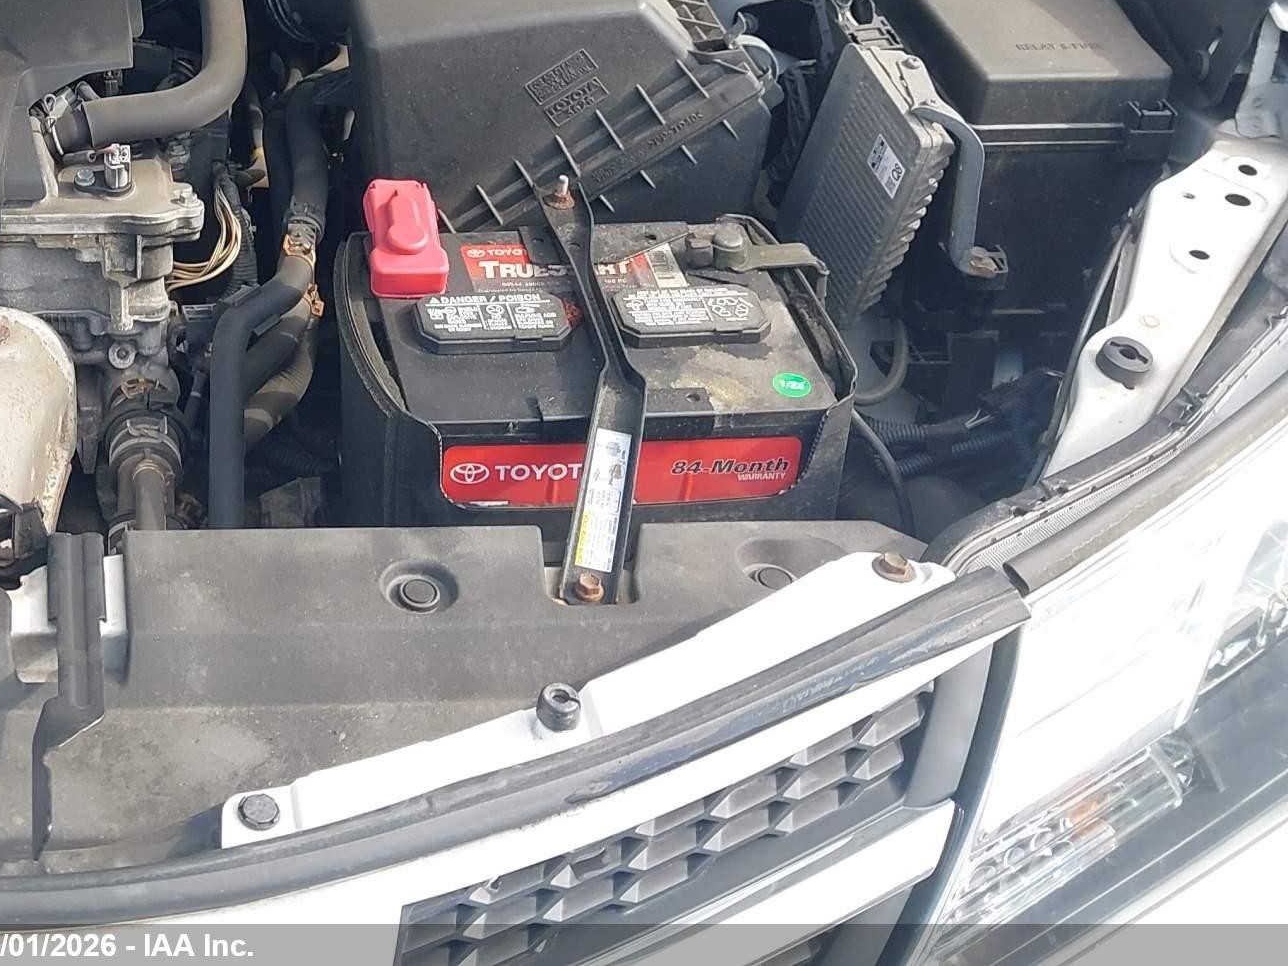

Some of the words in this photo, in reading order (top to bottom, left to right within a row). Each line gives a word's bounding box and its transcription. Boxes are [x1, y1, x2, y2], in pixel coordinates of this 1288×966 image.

[487, 248, 527, 257] TOYO
[440, 295, 487, 305] DANGER
[498, 293, 541, 302] POISON
[671, 457, 789, 475] 84-Month
[494, 463, 583, 482] TOYOT
[737, 473, 787, 481] WARRANTY
